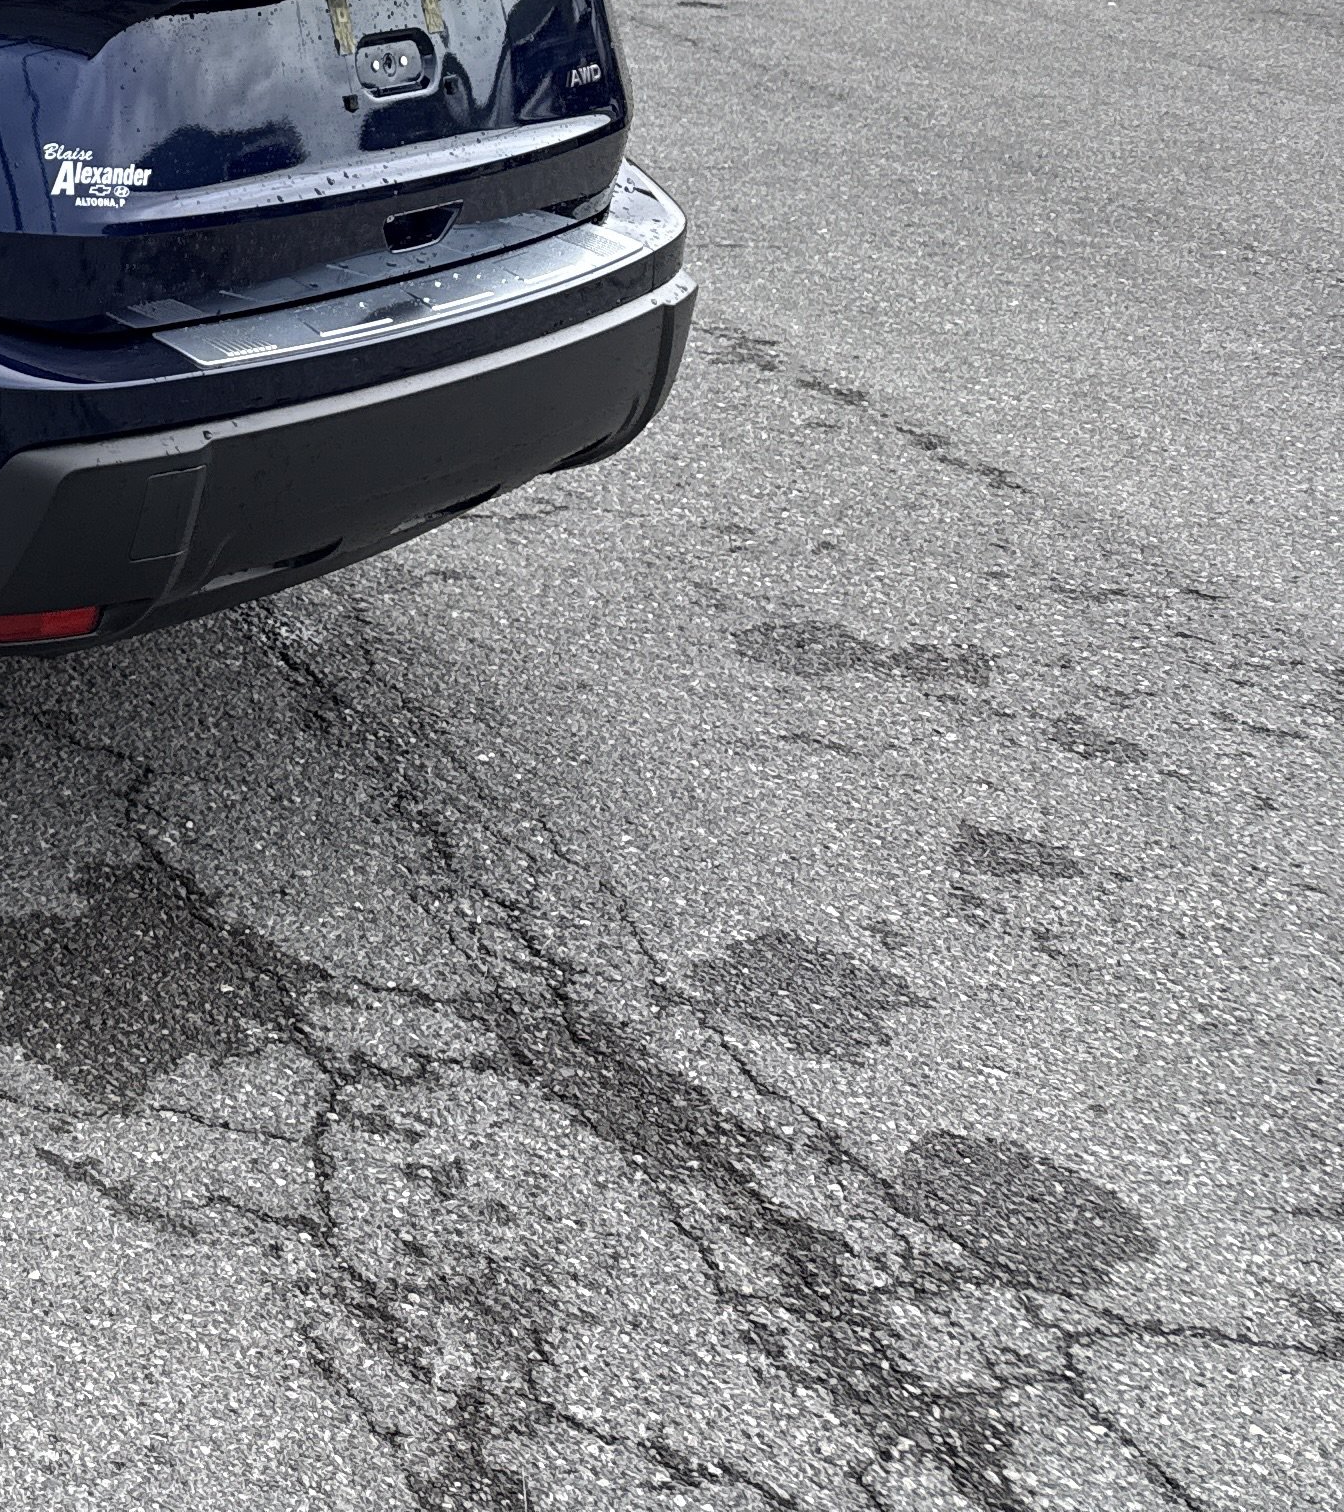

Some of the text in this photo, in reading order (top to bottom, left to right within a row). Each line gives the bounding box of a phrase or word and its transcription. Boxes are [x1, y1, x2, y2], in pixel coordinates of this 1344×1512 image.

[569, 63, 602, 88] AWD
[43, 143, 94, 161] Blaise
[50, 160, 153, 196] Alexander
